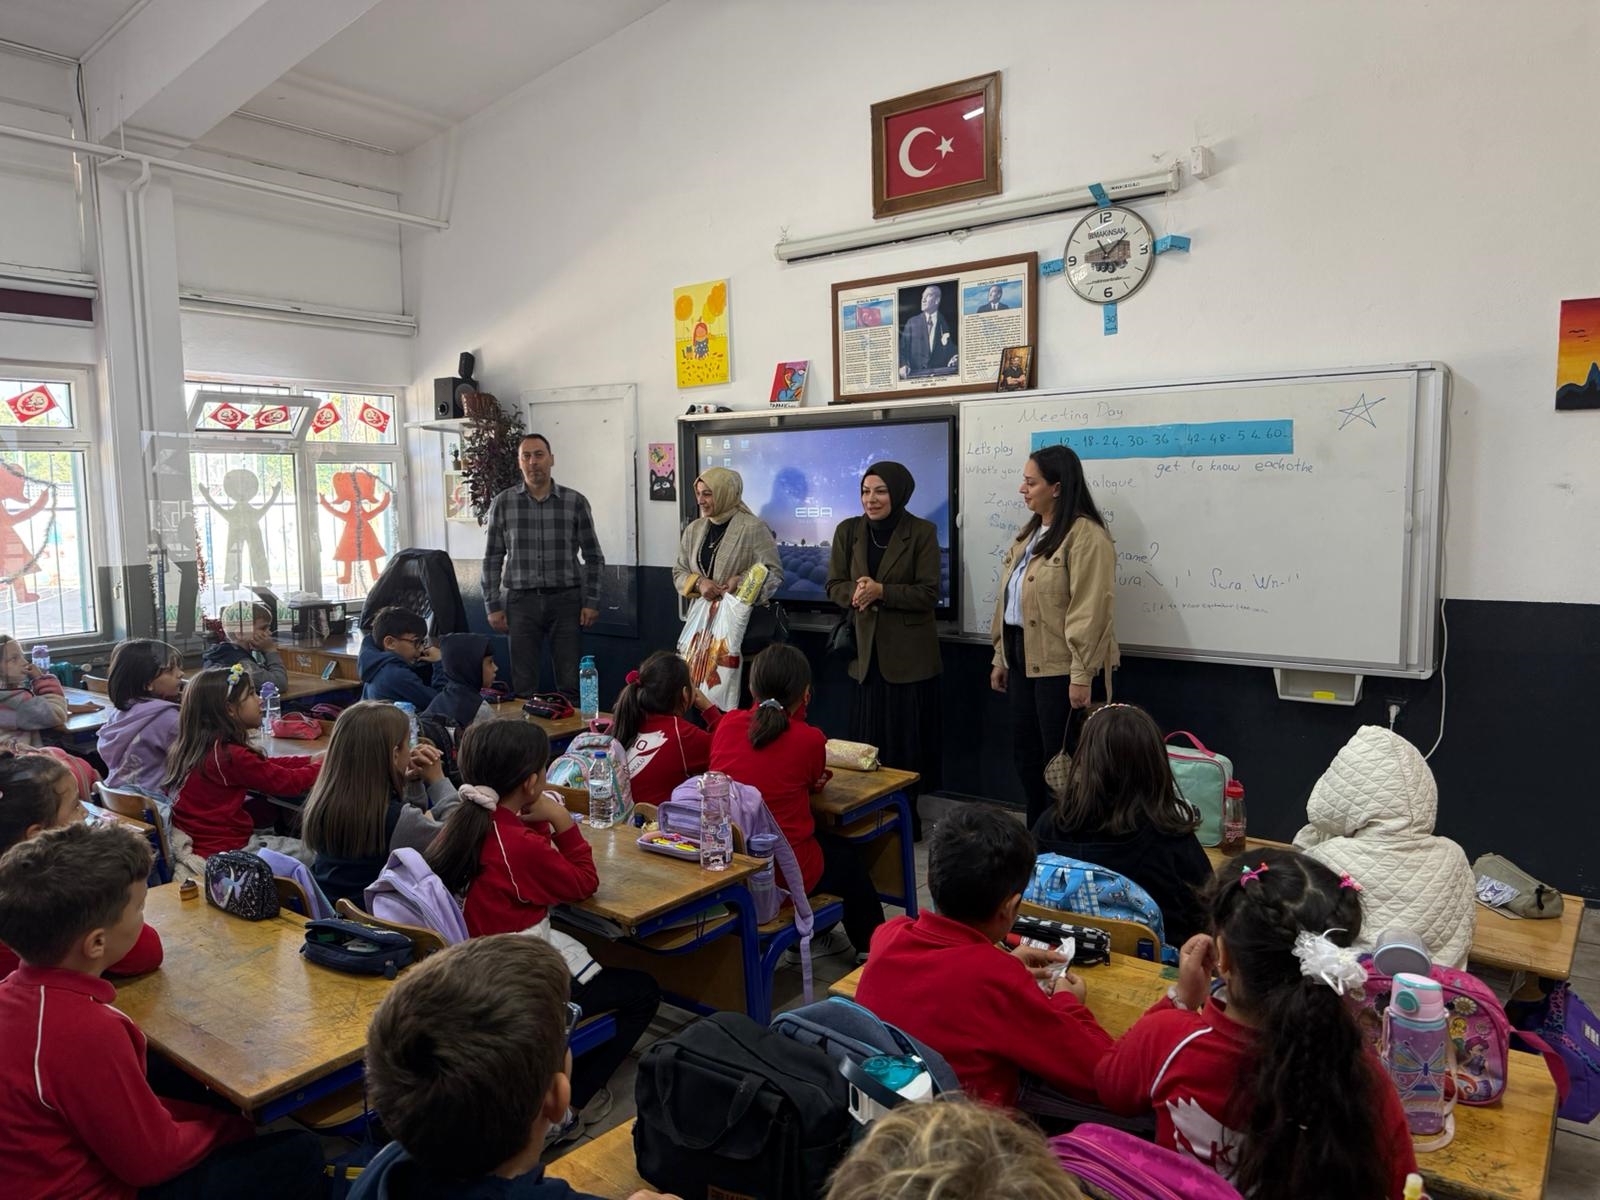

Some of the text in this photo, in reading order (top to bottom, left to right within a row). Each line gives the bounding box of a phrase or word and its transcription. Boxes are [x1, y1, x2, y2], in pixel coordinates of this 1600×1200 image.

[1100, 211, 1112, 224] 12
[1140, 243, 1148, 255] 3
[1068, 256, 1077, 267] 9
[1104, 287, 1113, 298] 6
[1018, 402, 1124, 425] Meeting Day
[994, 441, 1014, 459] play
[1154, 460, 1181, 479] get
[1209, 461, 1240, 472] know
[1087, 476, 1137, 495] ialogue
[795, 507, 832, 517] EBA
